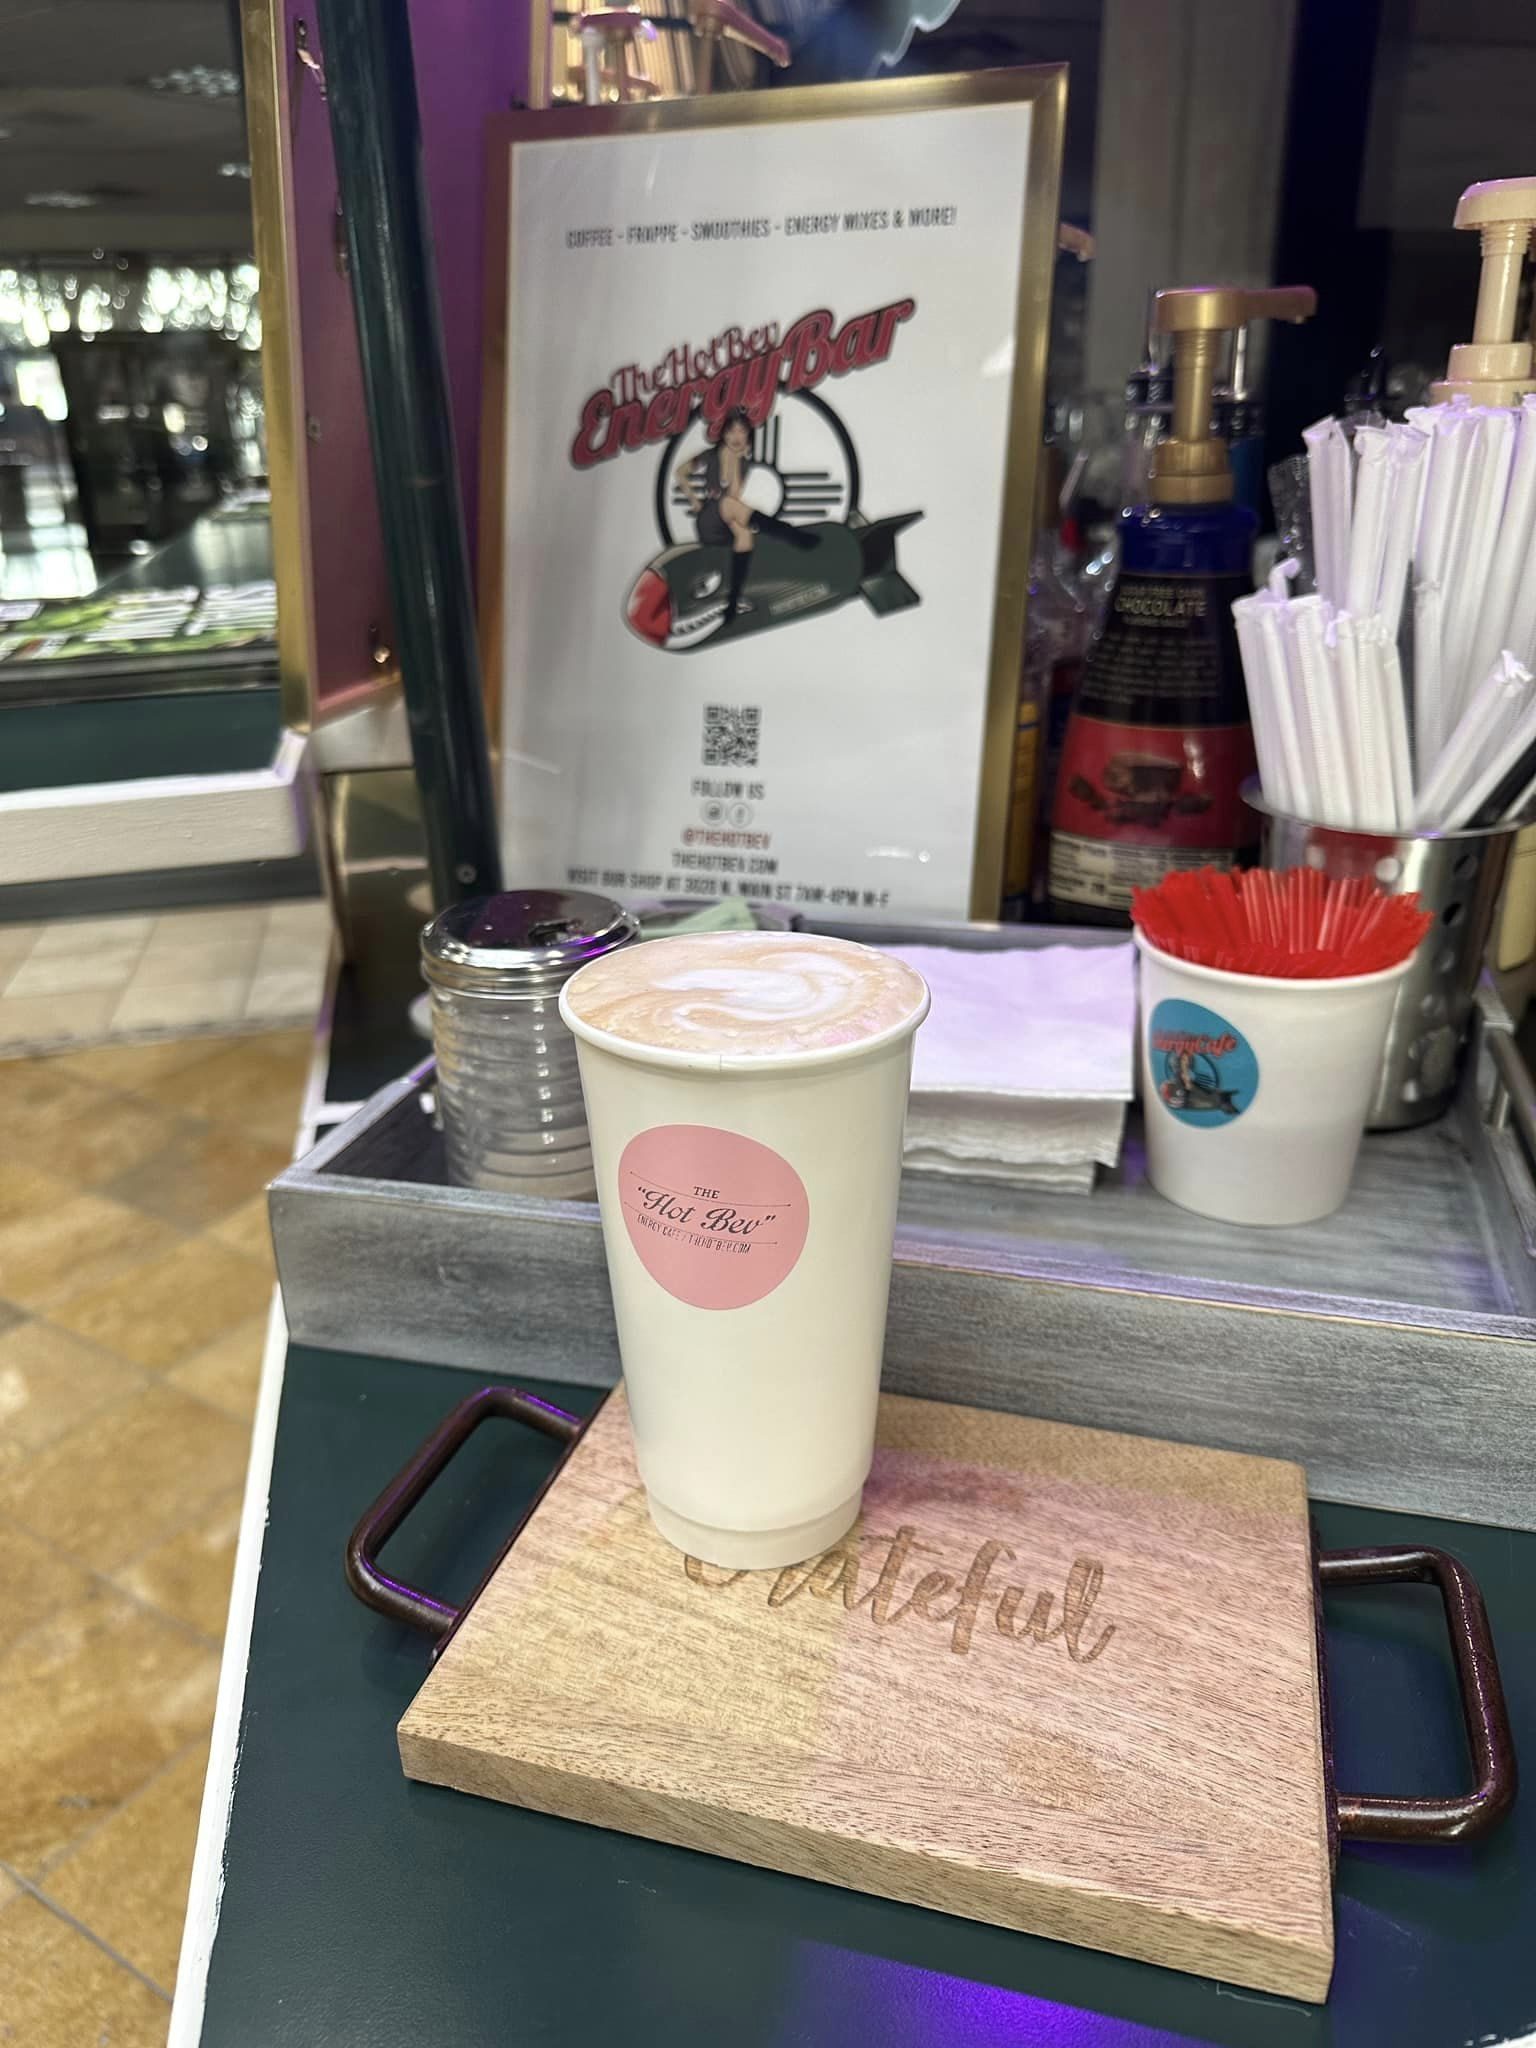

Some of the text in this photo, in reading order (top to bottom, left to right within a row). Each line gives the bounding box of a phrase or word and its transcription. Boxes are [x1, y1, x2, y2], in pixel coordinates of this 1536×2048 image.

[566, 227, 614, 249] COFFEE
[626, 223, 678, 244] FRAPPE
[691, 217, 771, 241] SMOOTHIES
[784, 213, 840, 236] ENERGY
[893, 208, 904, 229] &
[908, 205, 957, 228] MORE!
[611, 321, 779, 404] The Hot Bev
[1115, 598, 1208, 617] CHOCOLATE
[690, 780, 766, 800] FOLLOW US
[629, 873, 662, 890] SHOP
[694, 1186, 720, 1199] THE
[637, 1213, 662, 1233] ENERGY
